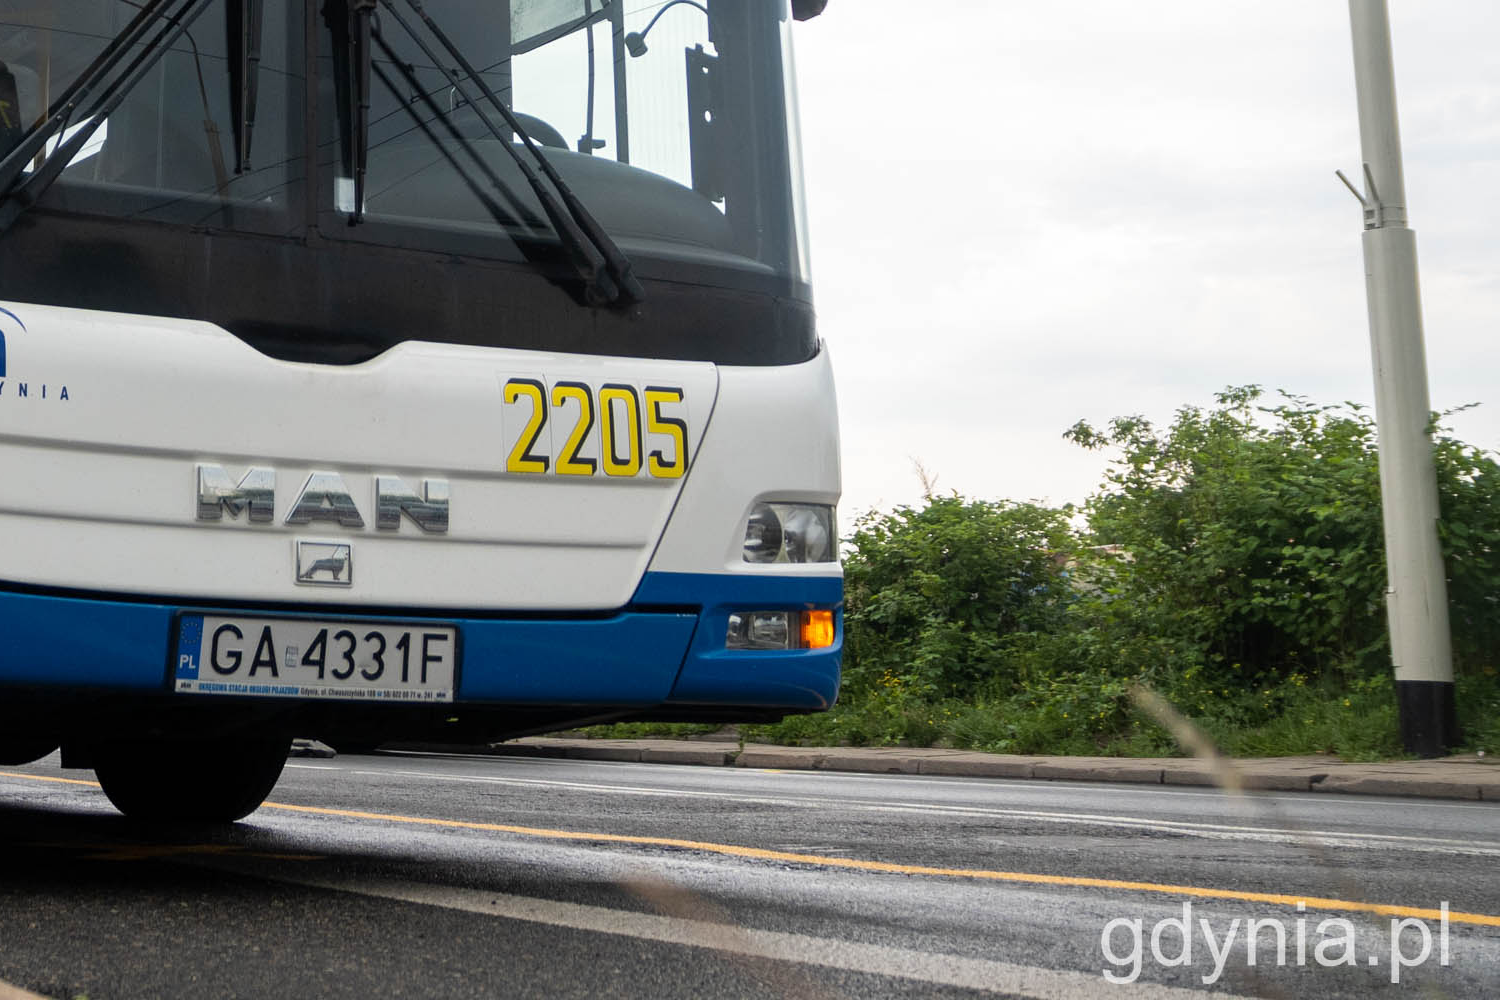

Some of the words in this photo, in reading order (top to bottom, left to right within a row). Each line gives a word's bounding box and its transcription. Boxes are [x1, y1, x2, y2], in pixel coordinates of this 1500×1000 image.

[503, 378, 689, 479] 2205
[195, 463, 449, 533] MAN
[179, 654, 196, 669] PL
[210, 623, 279, 678] GA
[301, 628, 449, 684] 4331F
